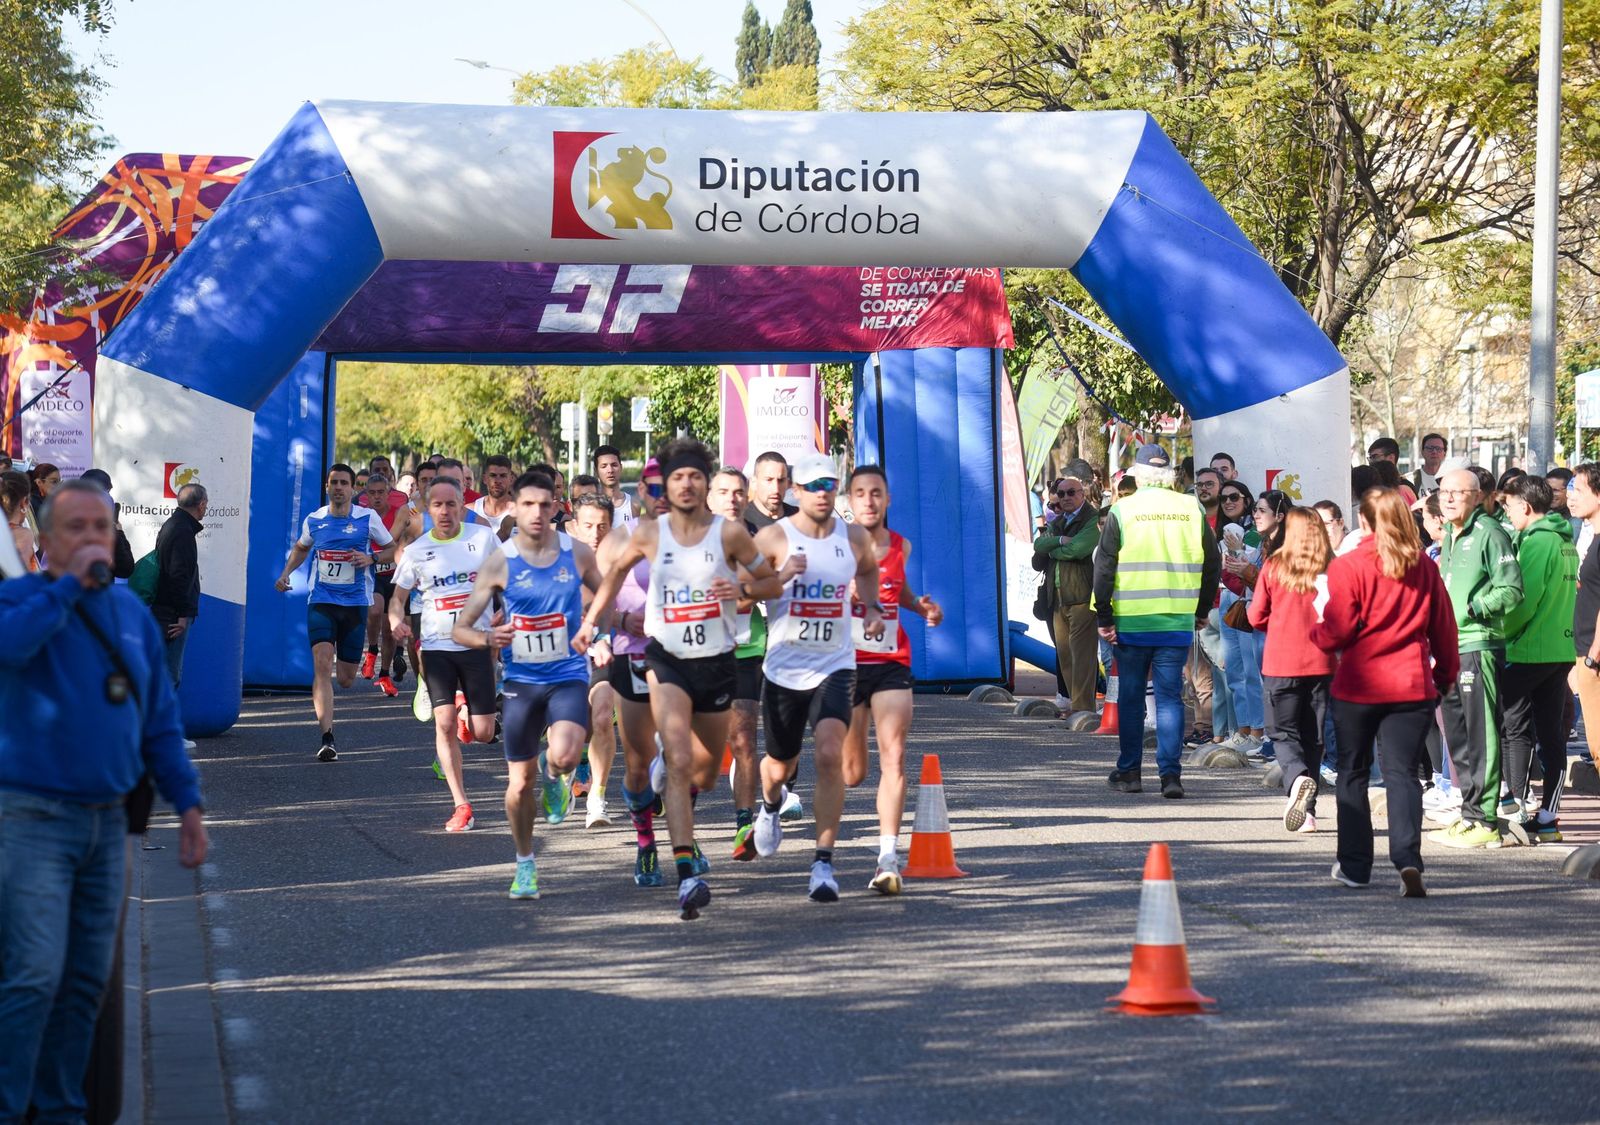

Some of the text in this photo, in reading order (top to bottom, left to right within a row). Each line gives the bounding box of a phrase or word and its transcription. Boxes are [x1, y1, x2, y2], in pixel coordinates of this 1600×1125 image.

[699, 157, 920, 199] Diputación
[695, 202, 920, 235] de Córdoba
[859, 267, 884, 281] DE
[887, 266, 956, 280] CORRER
[860, 279, 966, 297] SE TRATA DE
[859, 298, 929, 313] CORRER
[859, 313, 919, 330] MEJOR
[29, 400, 84, 412] IMDECO
[756, 405, 809, 417] IMDECO
[1135, 513, 1190, 522] VOLUNTARIOS
[327, 562, 342, 577] 27
[682, 624, 706, 647] 48
[798, 620, 834, 642] 216
[524, 632, 556, 653] 111
